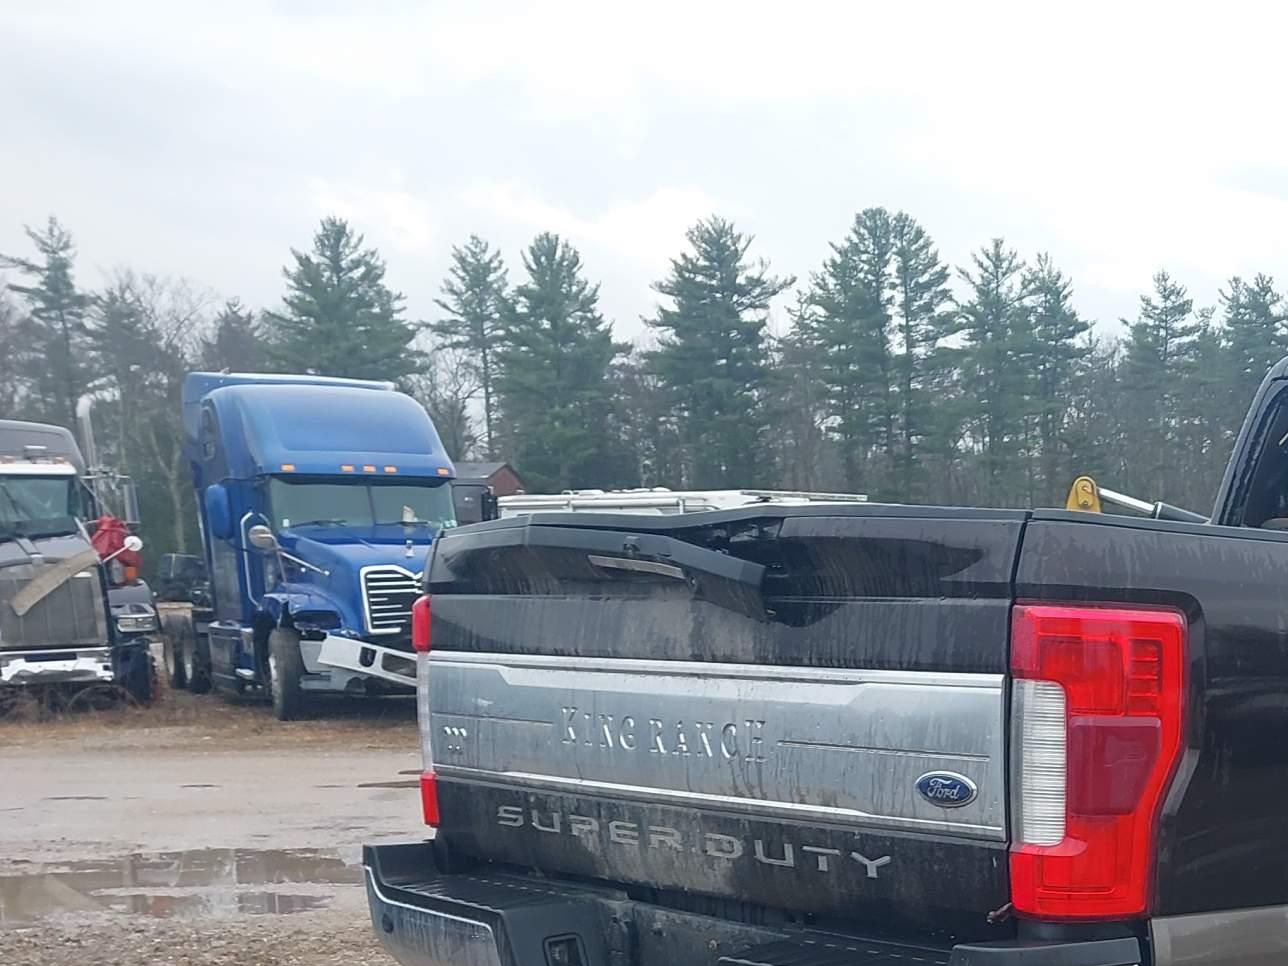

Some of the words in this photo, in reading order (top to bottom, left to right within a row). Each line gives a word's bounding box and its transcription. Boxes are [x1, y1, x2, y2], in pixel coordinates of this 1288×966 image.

[561, 706, 636, 751] KING
[648, 718, 766, 763] RANCH
[926, 777, 961, 800] Ford
[497, 805, 686, 853] SUPER
[703, 831, 892, 879] DUTY
